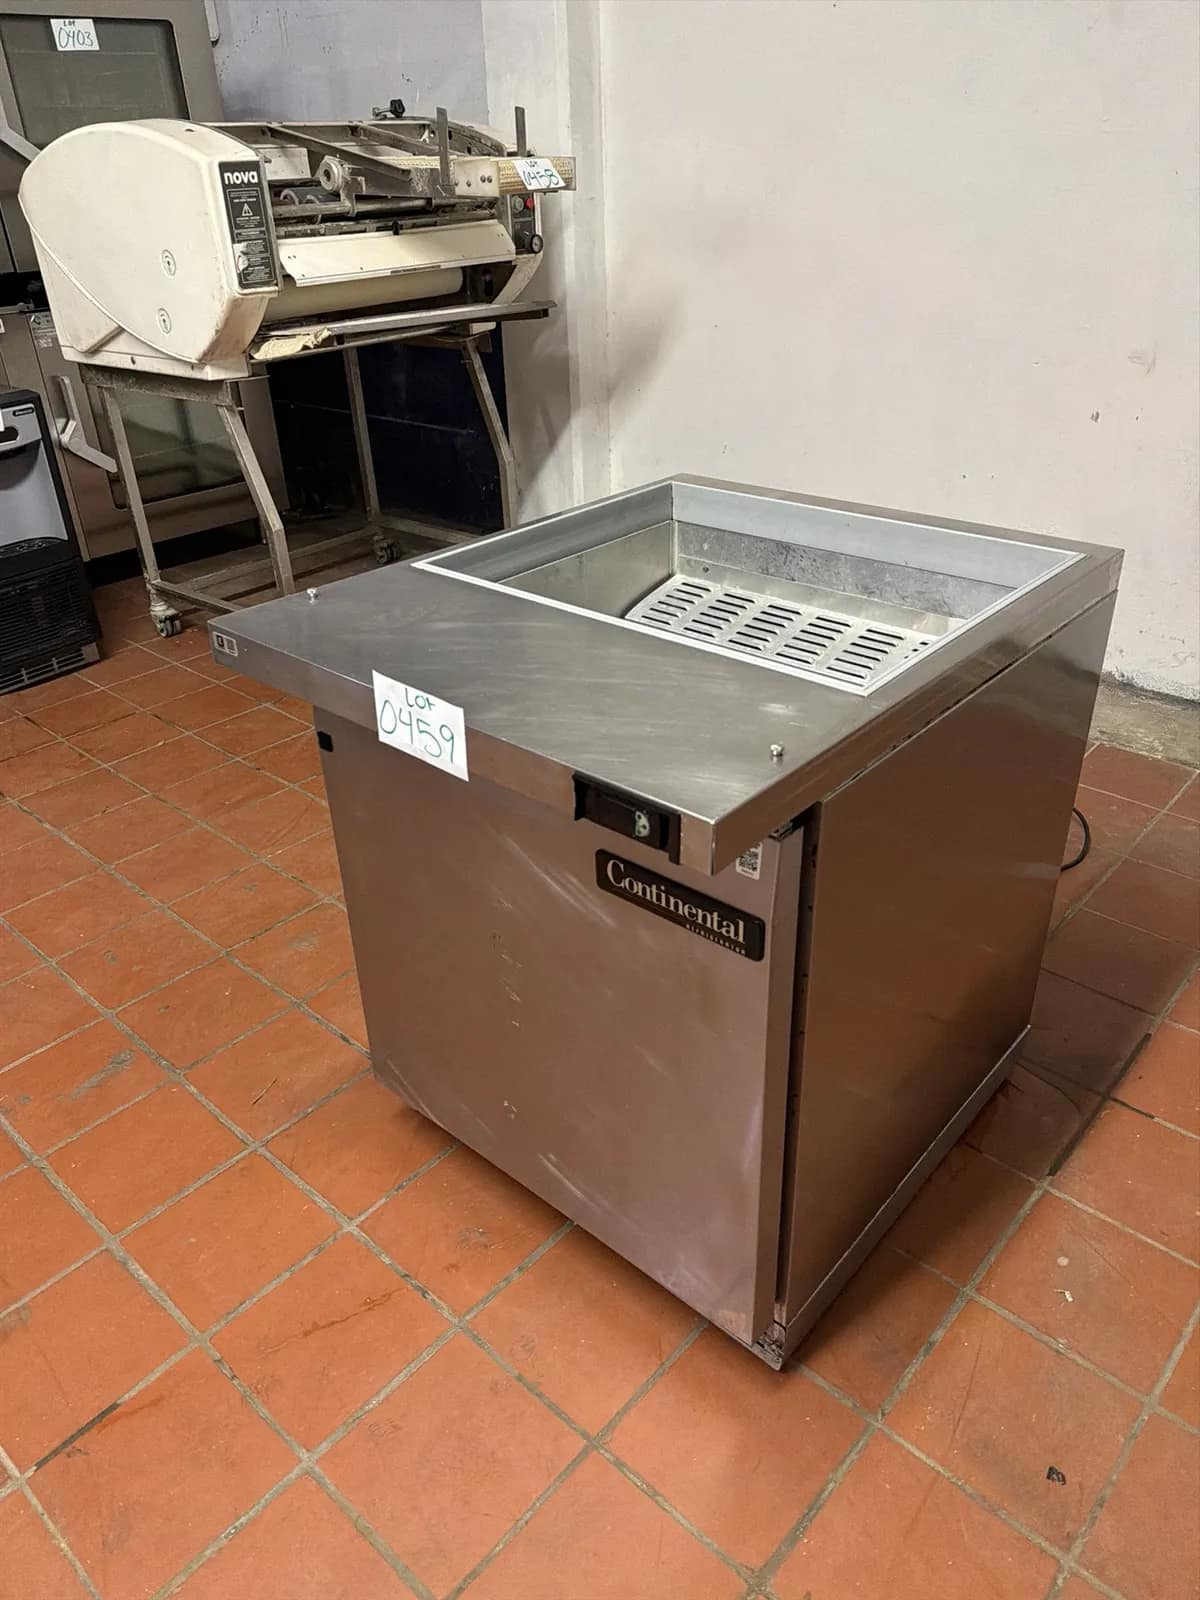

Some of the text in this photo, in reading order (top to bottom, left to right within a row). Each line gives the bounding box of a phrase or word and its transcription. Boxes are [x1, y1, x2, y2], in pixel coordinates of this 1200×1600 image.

[58, 27, 94, 49] 0403
[223, 170, 259, 185] nova
[379, 699, 455, 765] 0459
[606, 859, 747, 945] Continental
